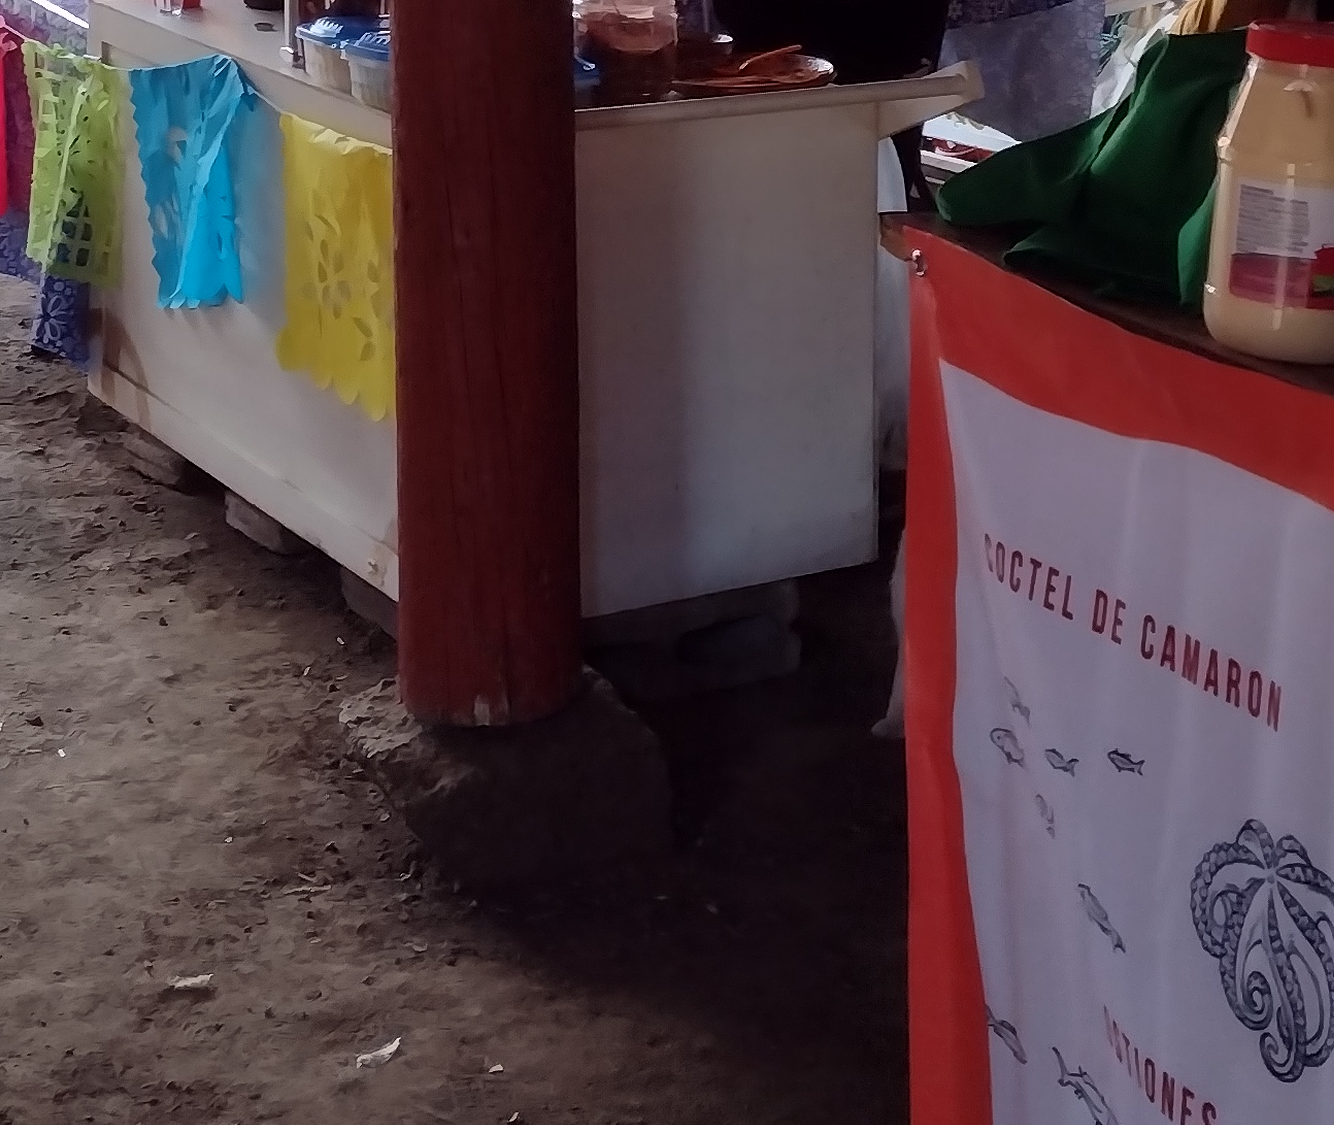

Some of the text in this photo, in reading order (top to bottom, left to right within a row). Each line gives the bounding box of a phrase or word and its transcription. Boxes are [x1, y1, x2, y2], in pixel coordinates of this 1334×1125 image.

[1091, 588, 1127, 645] DE
[1139, 614, 1283, 733] CAMARON
[1103, 1004, 1218, 1125] TIONE
